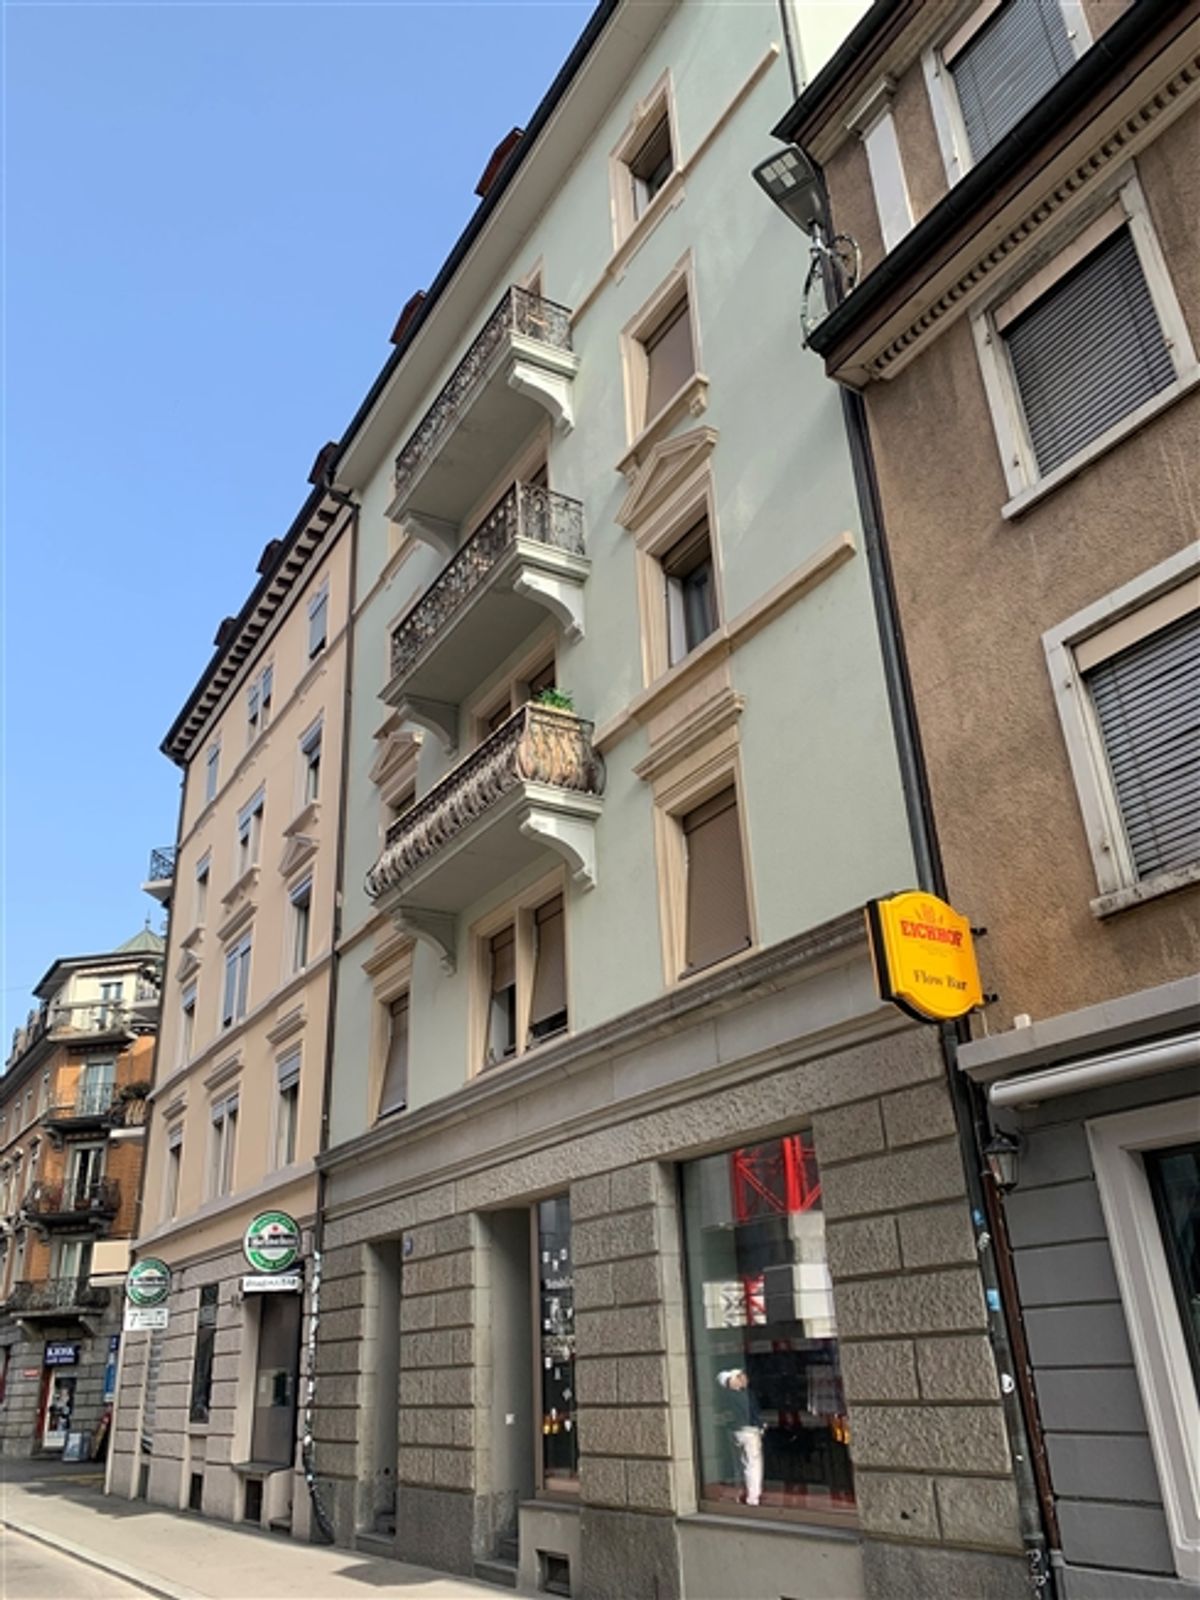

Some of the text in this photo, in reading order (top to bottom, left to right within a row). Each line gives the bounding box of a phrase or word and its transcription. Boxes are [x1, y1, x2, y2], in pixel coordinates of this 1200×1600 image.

[901, 920, 963, 947] EICHHOF
[913, 969, 968, 991] Flow Bar
